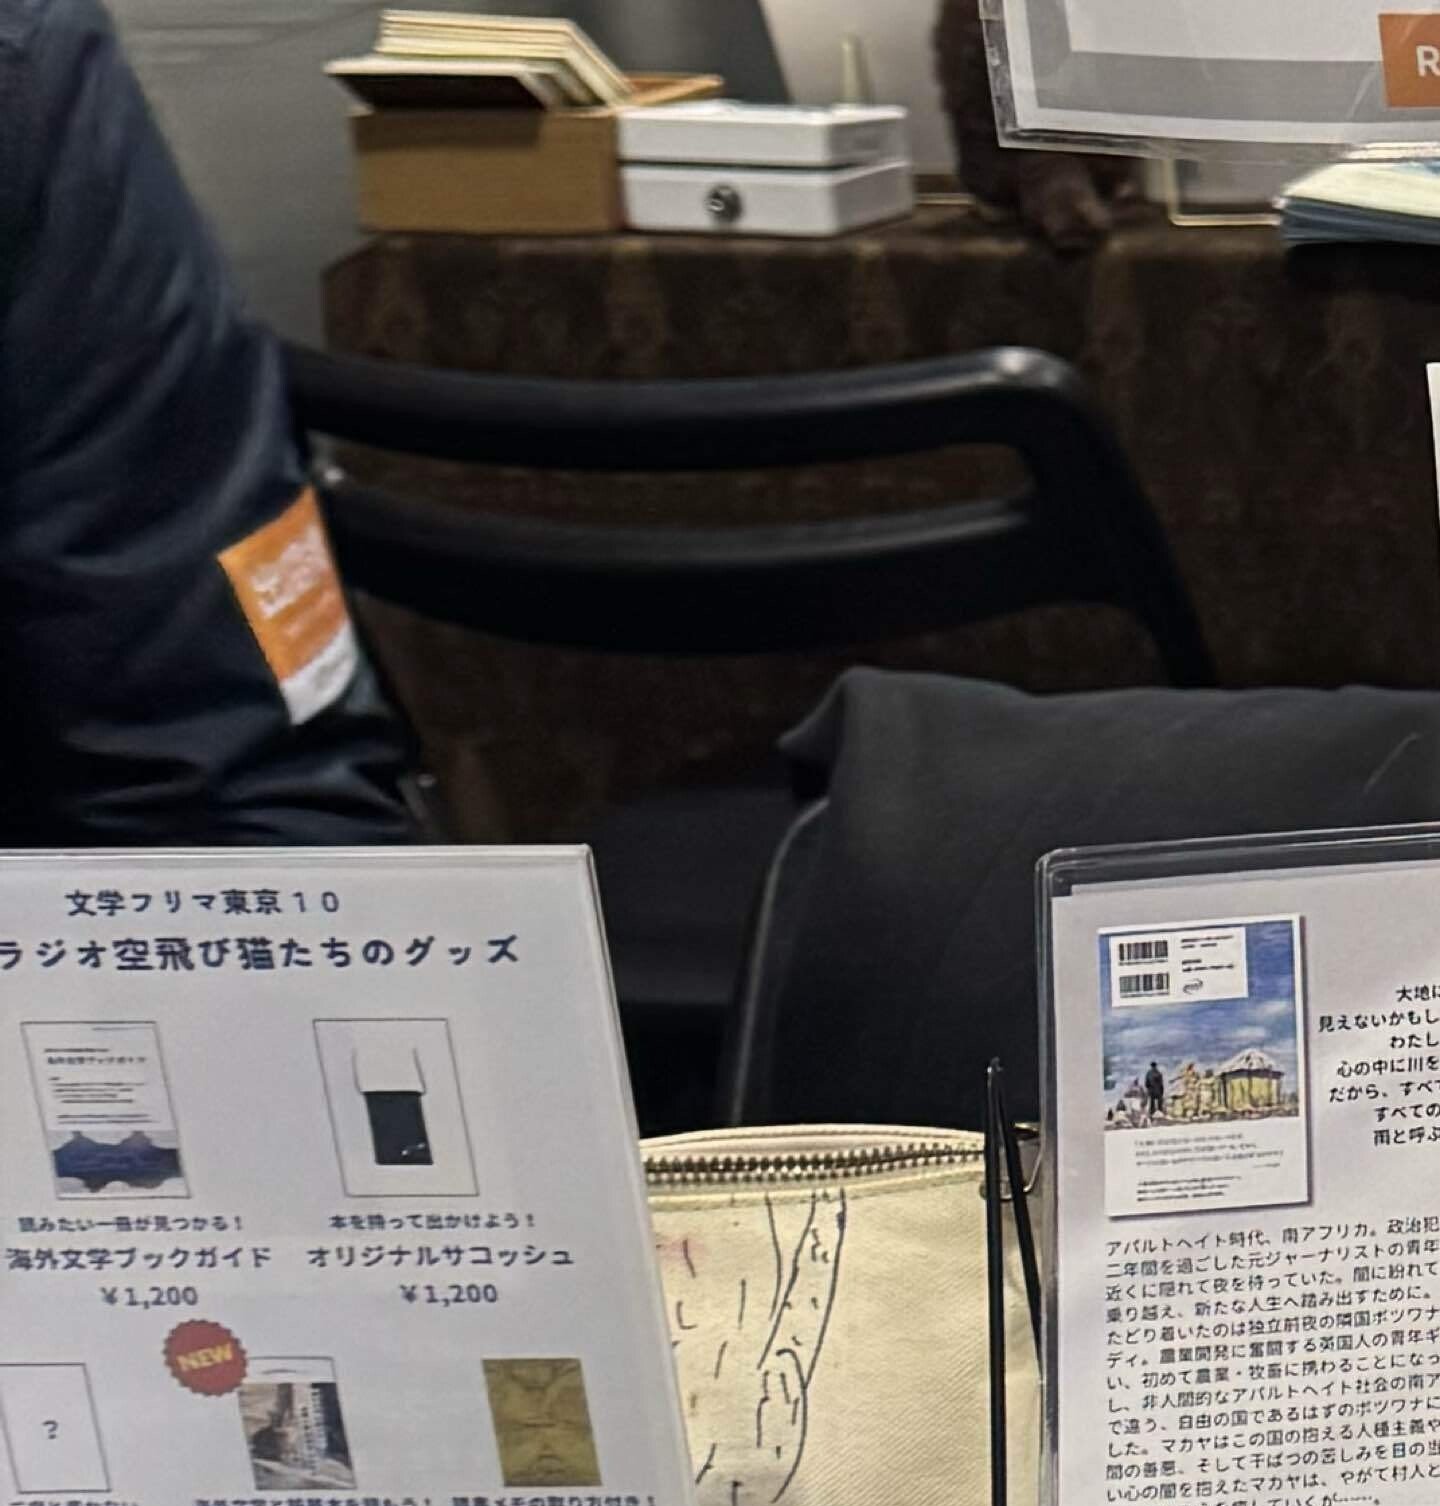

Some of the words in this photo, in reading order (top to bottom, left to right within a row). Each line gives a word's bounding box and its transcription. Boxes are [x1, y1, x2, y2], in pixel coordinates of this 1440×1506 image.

[7, 1247, 271, 1271] 海外文学ブックガイド
[307, 1244, 575, 1269] オリジナルサコッシュ
[100, 1286, 199, 1310] ¥1,200
[399, 1283, 498, 1307] ¥1,200
[177, 1342, 235, 1372] NEW
